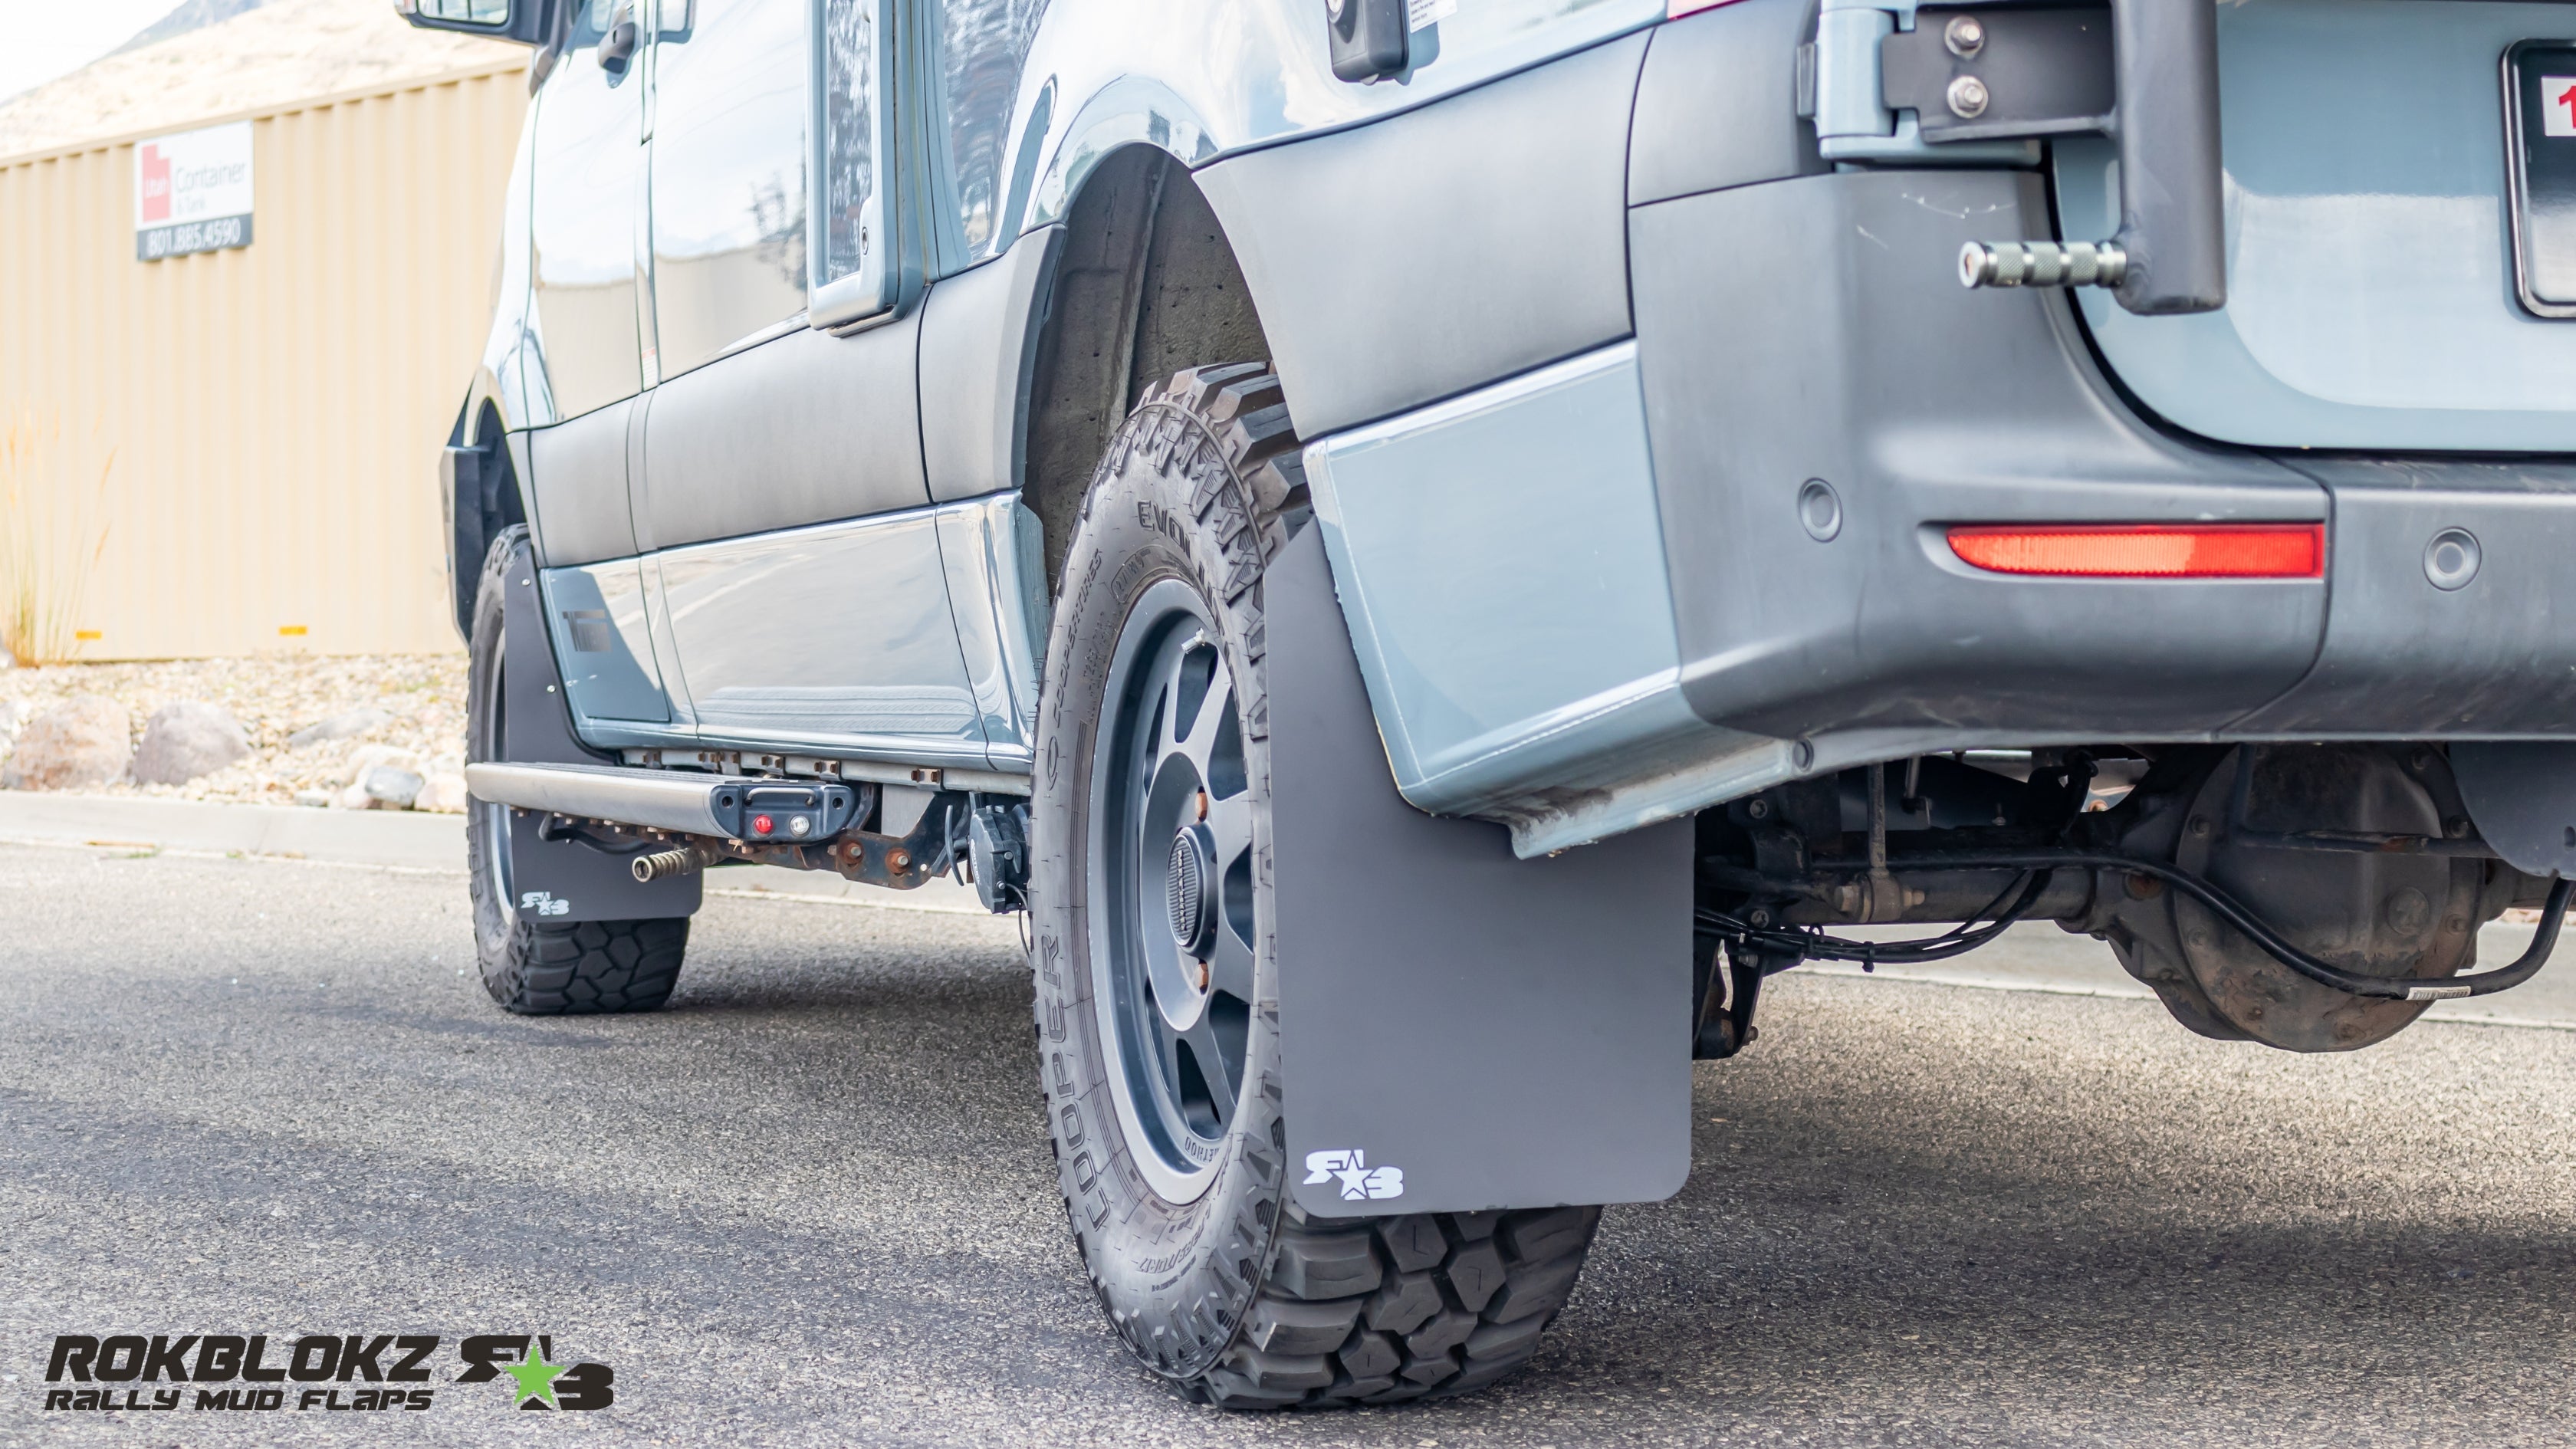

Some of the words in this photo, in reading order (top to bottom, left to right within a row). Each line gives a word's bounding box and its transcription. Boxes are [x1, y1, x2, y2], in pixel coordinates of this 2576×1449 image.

[176, 163, 246, 192] Container
[147, 218, 241, 256] 801.885.4590
[1039, 933, 1111, 1232] COOPER
